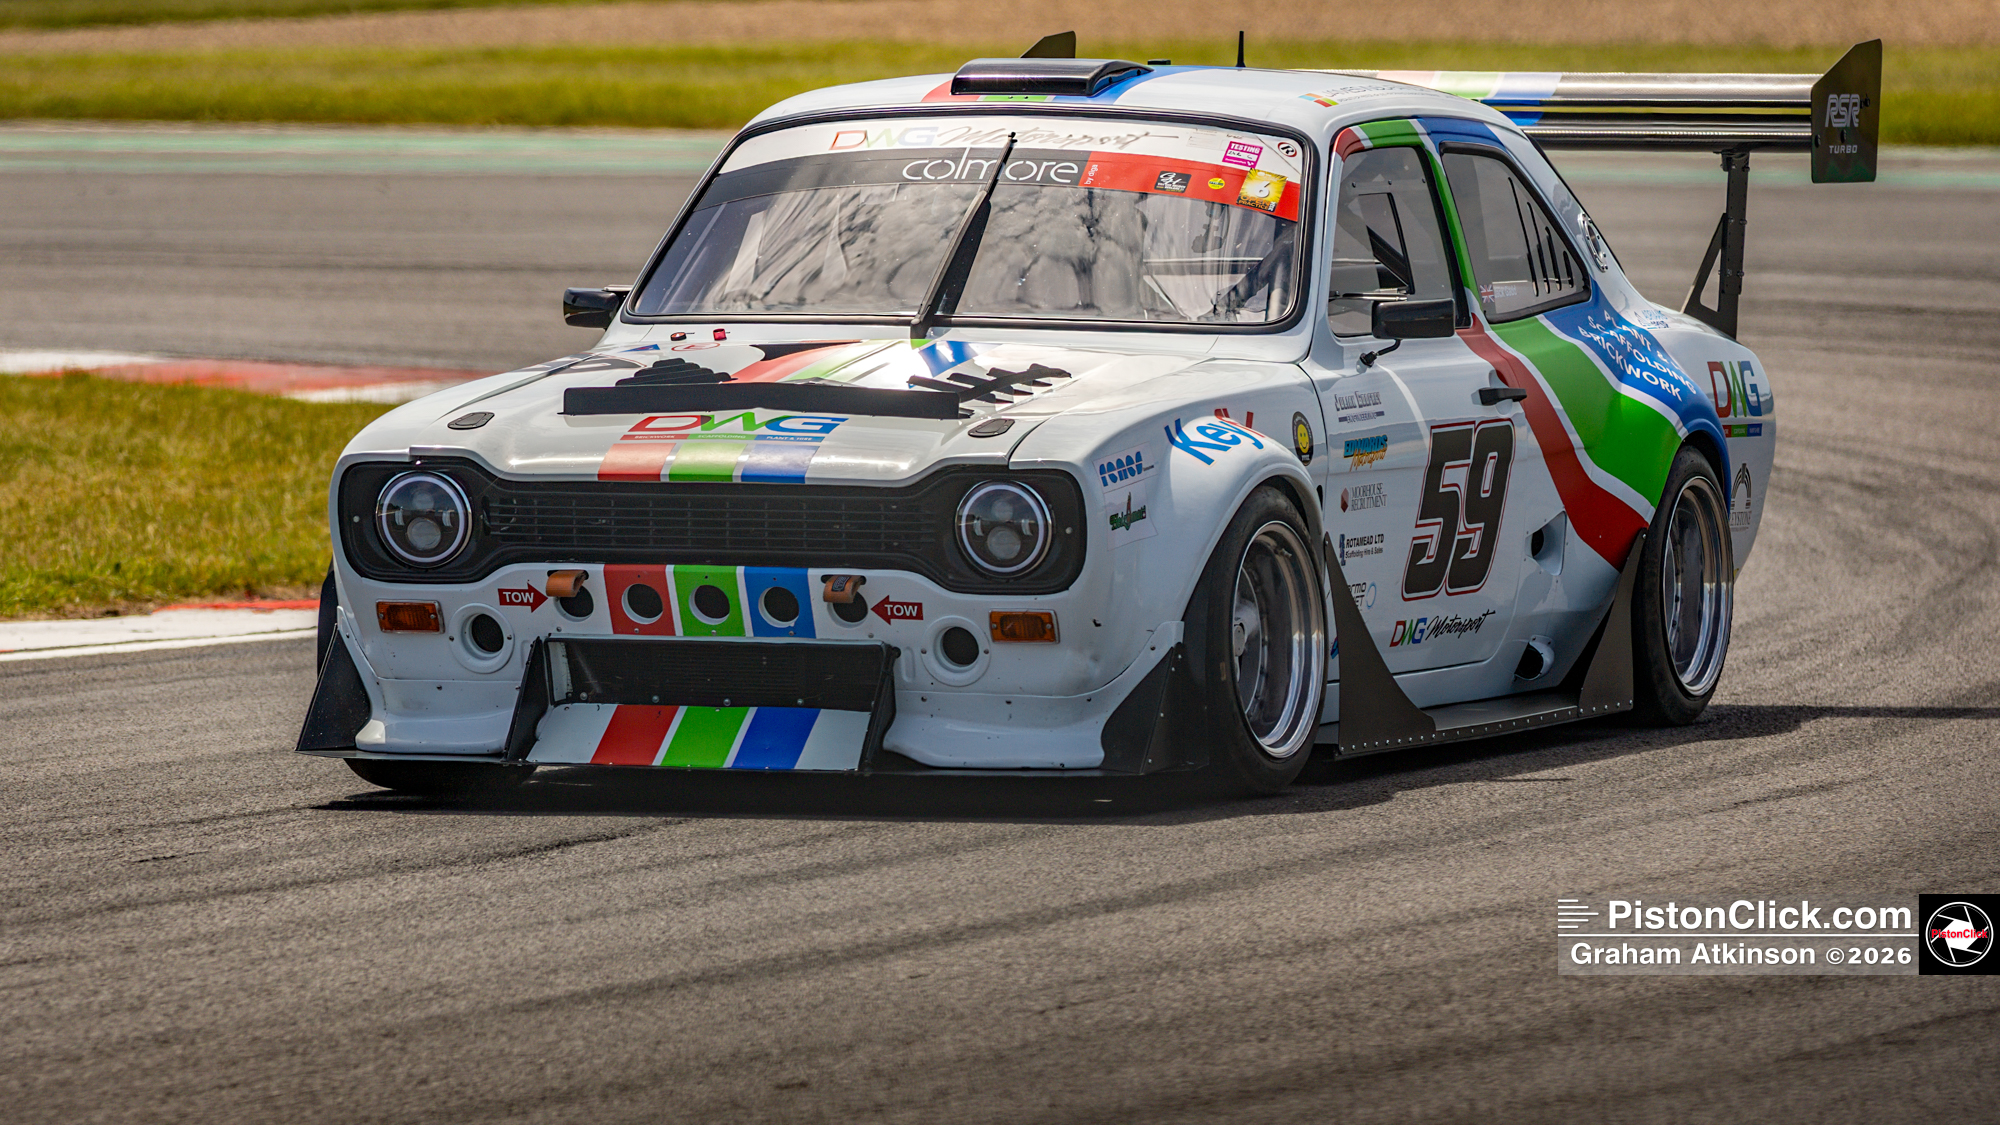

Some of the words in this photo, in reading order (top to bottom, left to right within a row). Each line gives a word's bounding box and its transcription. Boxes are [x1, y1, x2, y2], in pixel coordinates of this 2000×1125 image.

[1825, 94, 1860, 127] RSR
[829, 126, 938, 150] DWG
[938, 126, 1179, 149] Motorsport
[1230, 143, 1261, 154] TESTING
[1829, 145, 1858, 154] TURBO
[903, 147, 1078, 183] colmore
[1254, 180, 1270, 198] 6
[1238, 200, 1269, 210] PRACTICE
[1240, 195, 1271, 207] OPEN
[1604, 310, 1651, 352] PLANT
[1578, 326, 1682, 401] BRICKWORK
[1587, 315, 1697, 394] SCAFFOLDING
[1707, 361, 1762, 418] DWG
[628, 412, 849, 434] DWG
[1344, 434, 1388, 458] EDWARDS
[1351, 483, 1383, 498] MOORHOUSE
[1351, 494, 1387, 511] RECRUITMENT
[1402, 418, 1516, 601] 59
[1346, 535, 1373, 548] ROTAMEAD
[1374, 534, 1384, 545] LTD
[1345, 549, 1363, 558] Scaffolding
[502, 591, 534, 603] TOW
[885, 604, 918, 617] TOW
[1389, 617, 1428, 647] DWG
[1425, 609, 1496, 640] Motorsport
